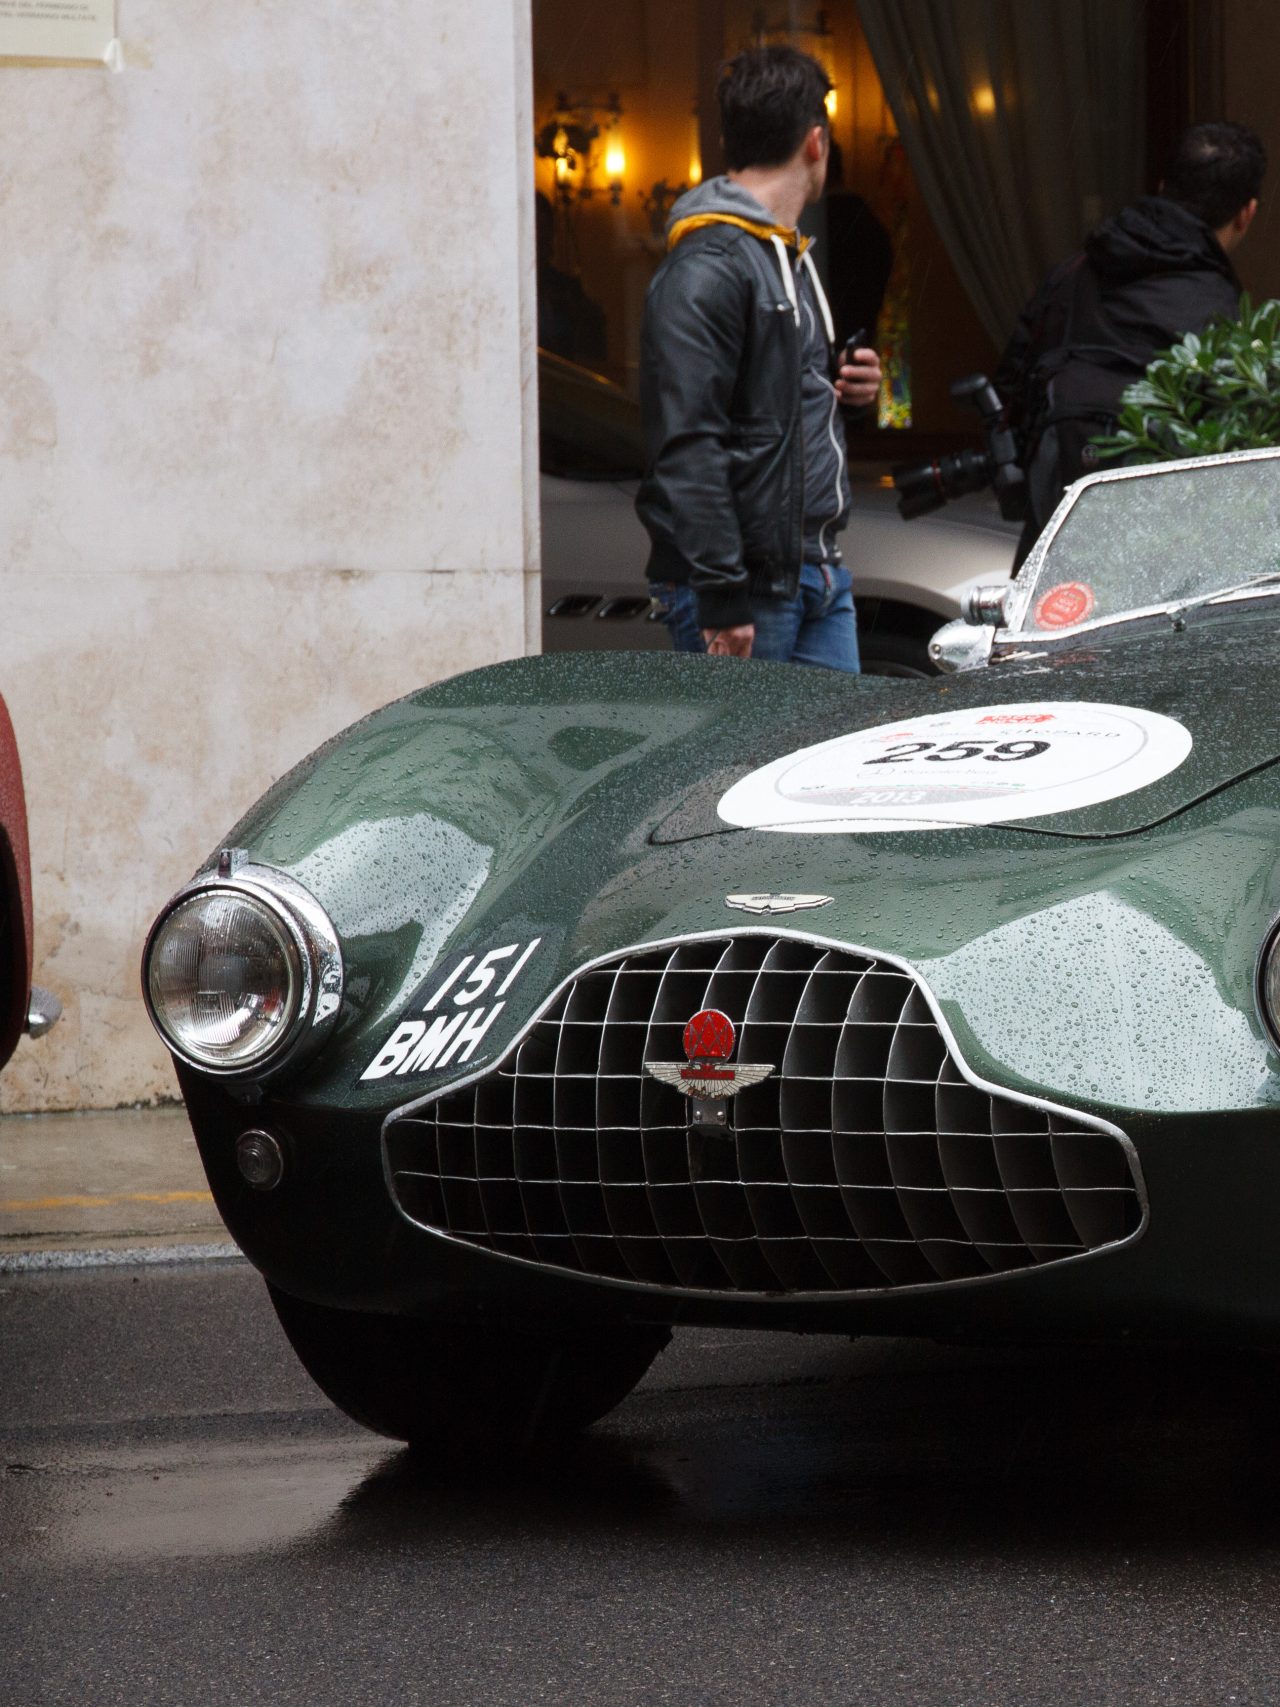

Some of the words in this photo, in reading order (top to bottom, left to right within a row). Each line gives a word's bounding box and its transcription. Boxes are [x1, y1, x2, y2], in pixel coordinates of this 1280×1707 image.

[862, 740, 1051, 765] 259
[850, 791, 928, 807] 2013
[422, 937, 542, 1012] 151
[359, 1001, 506, 1080] BMH
